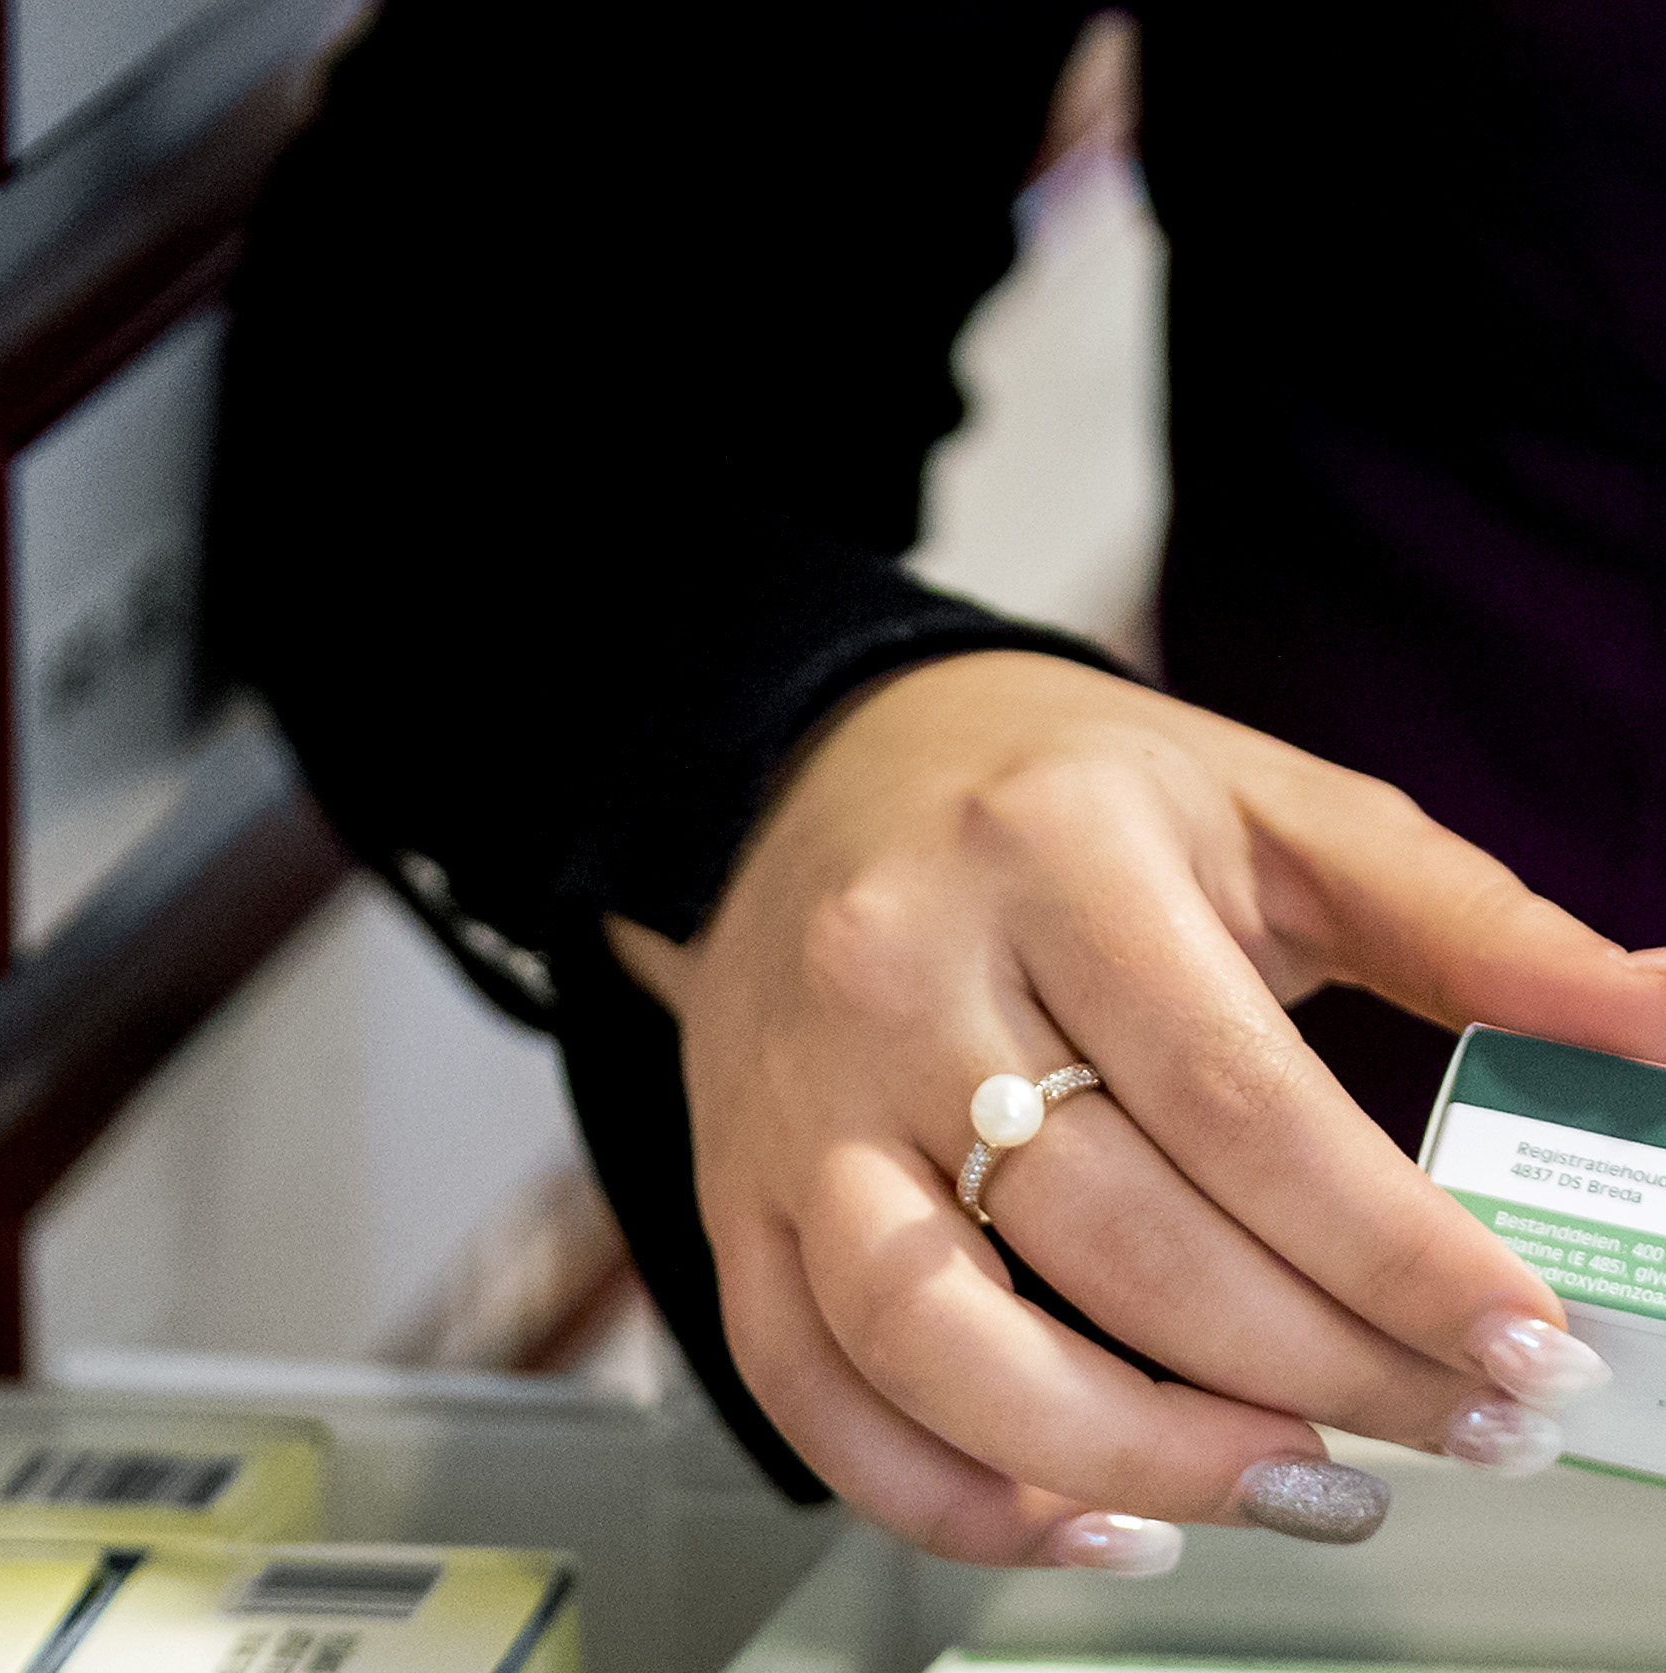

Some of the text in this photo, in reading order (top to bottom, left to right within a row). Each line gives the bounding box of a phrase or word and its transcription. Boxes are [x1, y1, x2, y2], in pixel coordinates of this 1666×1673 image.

[1557, 1171, 1582, 1191] DS
[1587, 1178, 1643, 1205] Breda
[1497, 1235, 1564, 1261] elatine
[1632, 1242, 1665, 1263] 400
